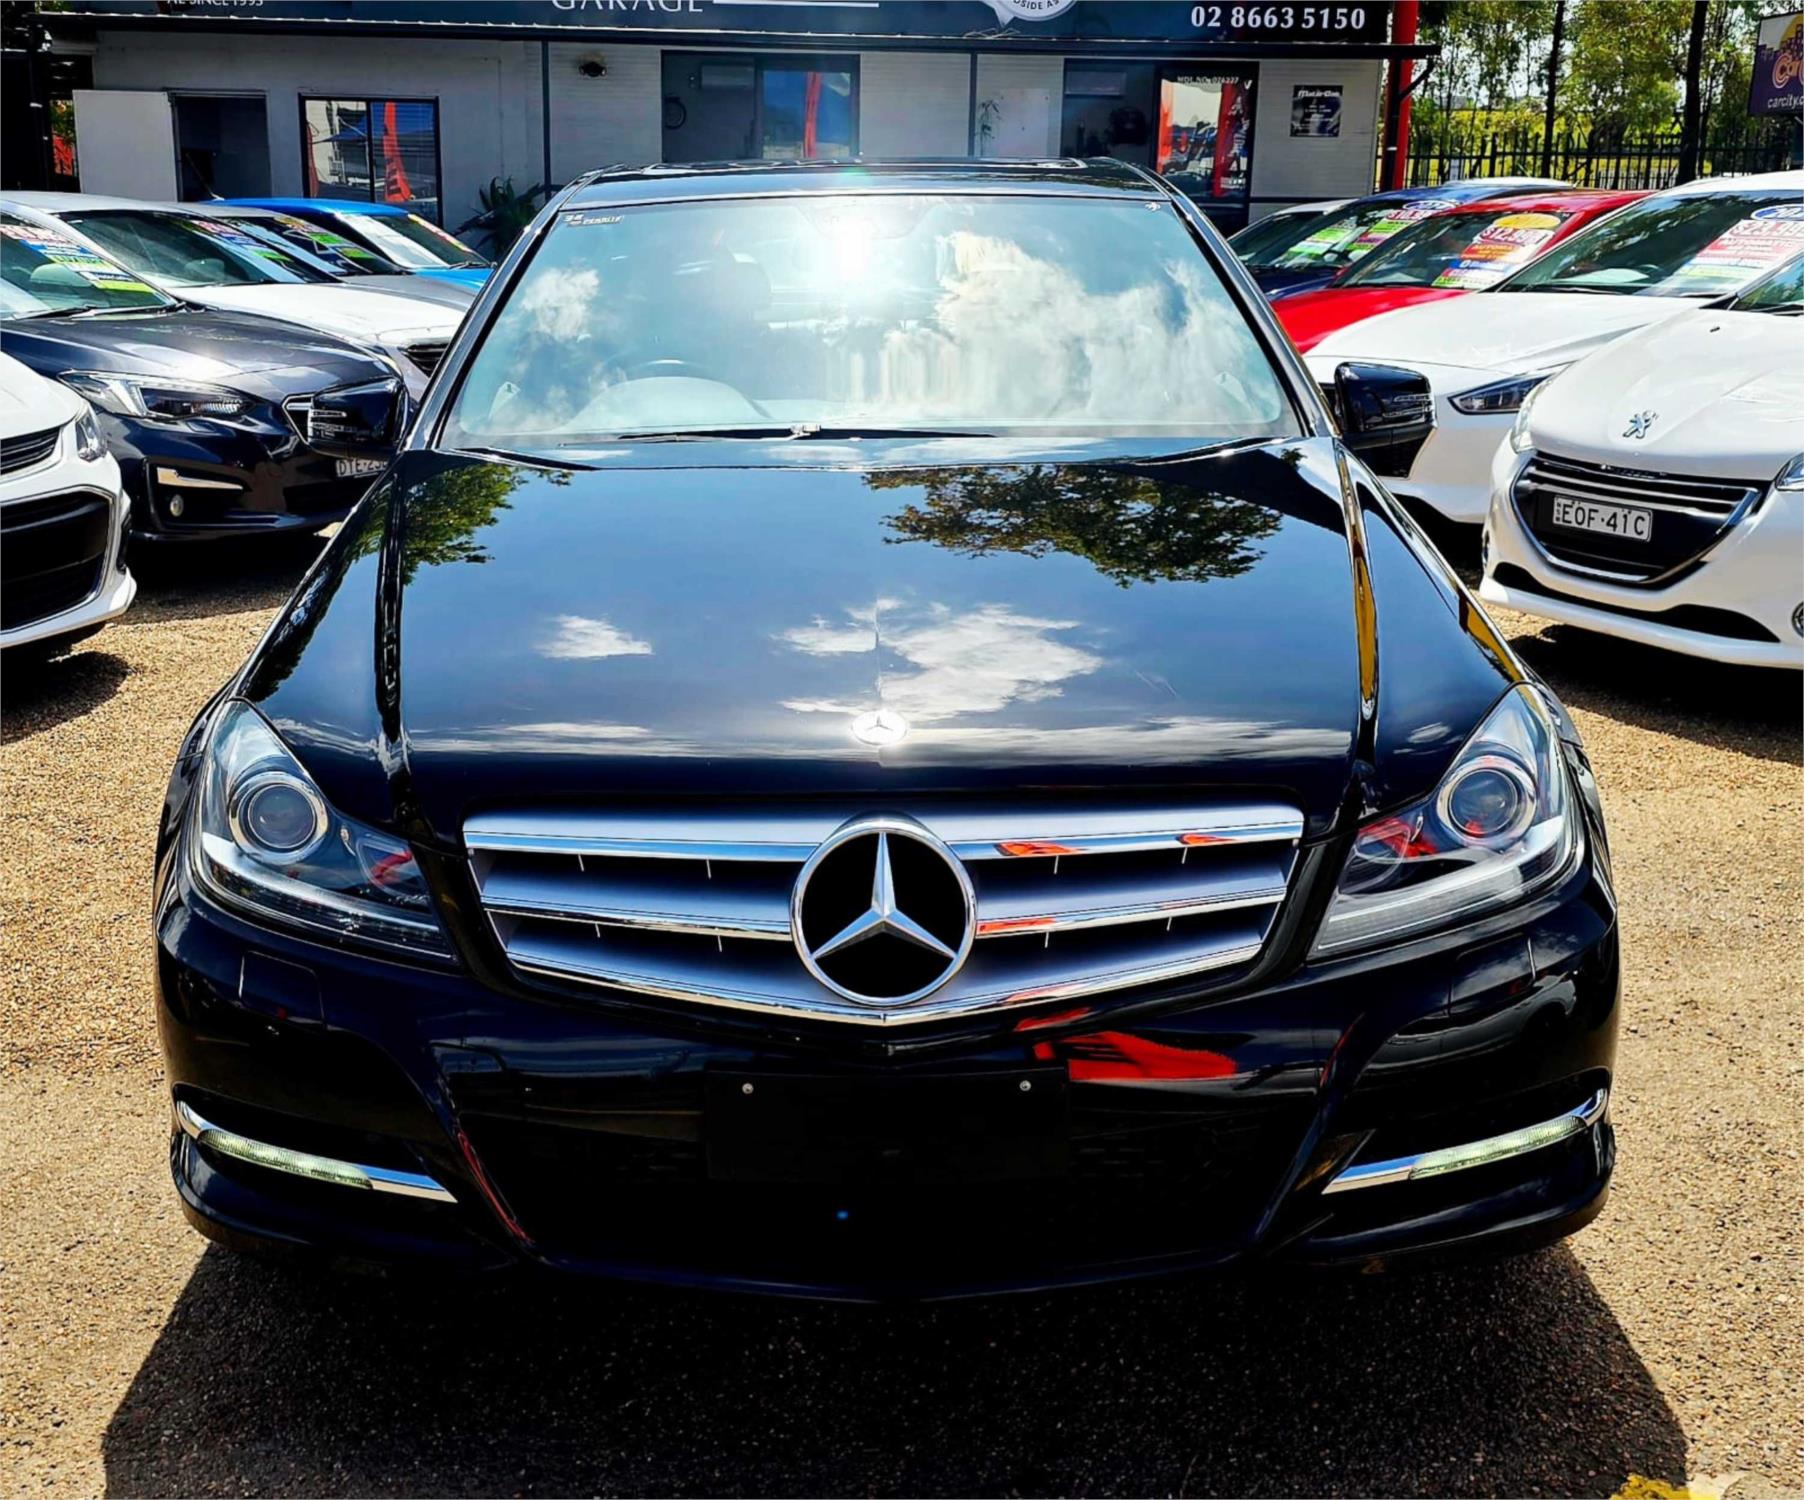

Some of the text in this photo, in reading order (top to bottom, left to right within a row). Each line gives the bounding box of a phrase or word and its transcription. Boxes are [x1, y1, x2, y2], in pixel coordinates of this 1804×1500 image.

[552, 0, 703, 12] GARAGE
[1190, 6, 1366, 30] 02 8663 5150
